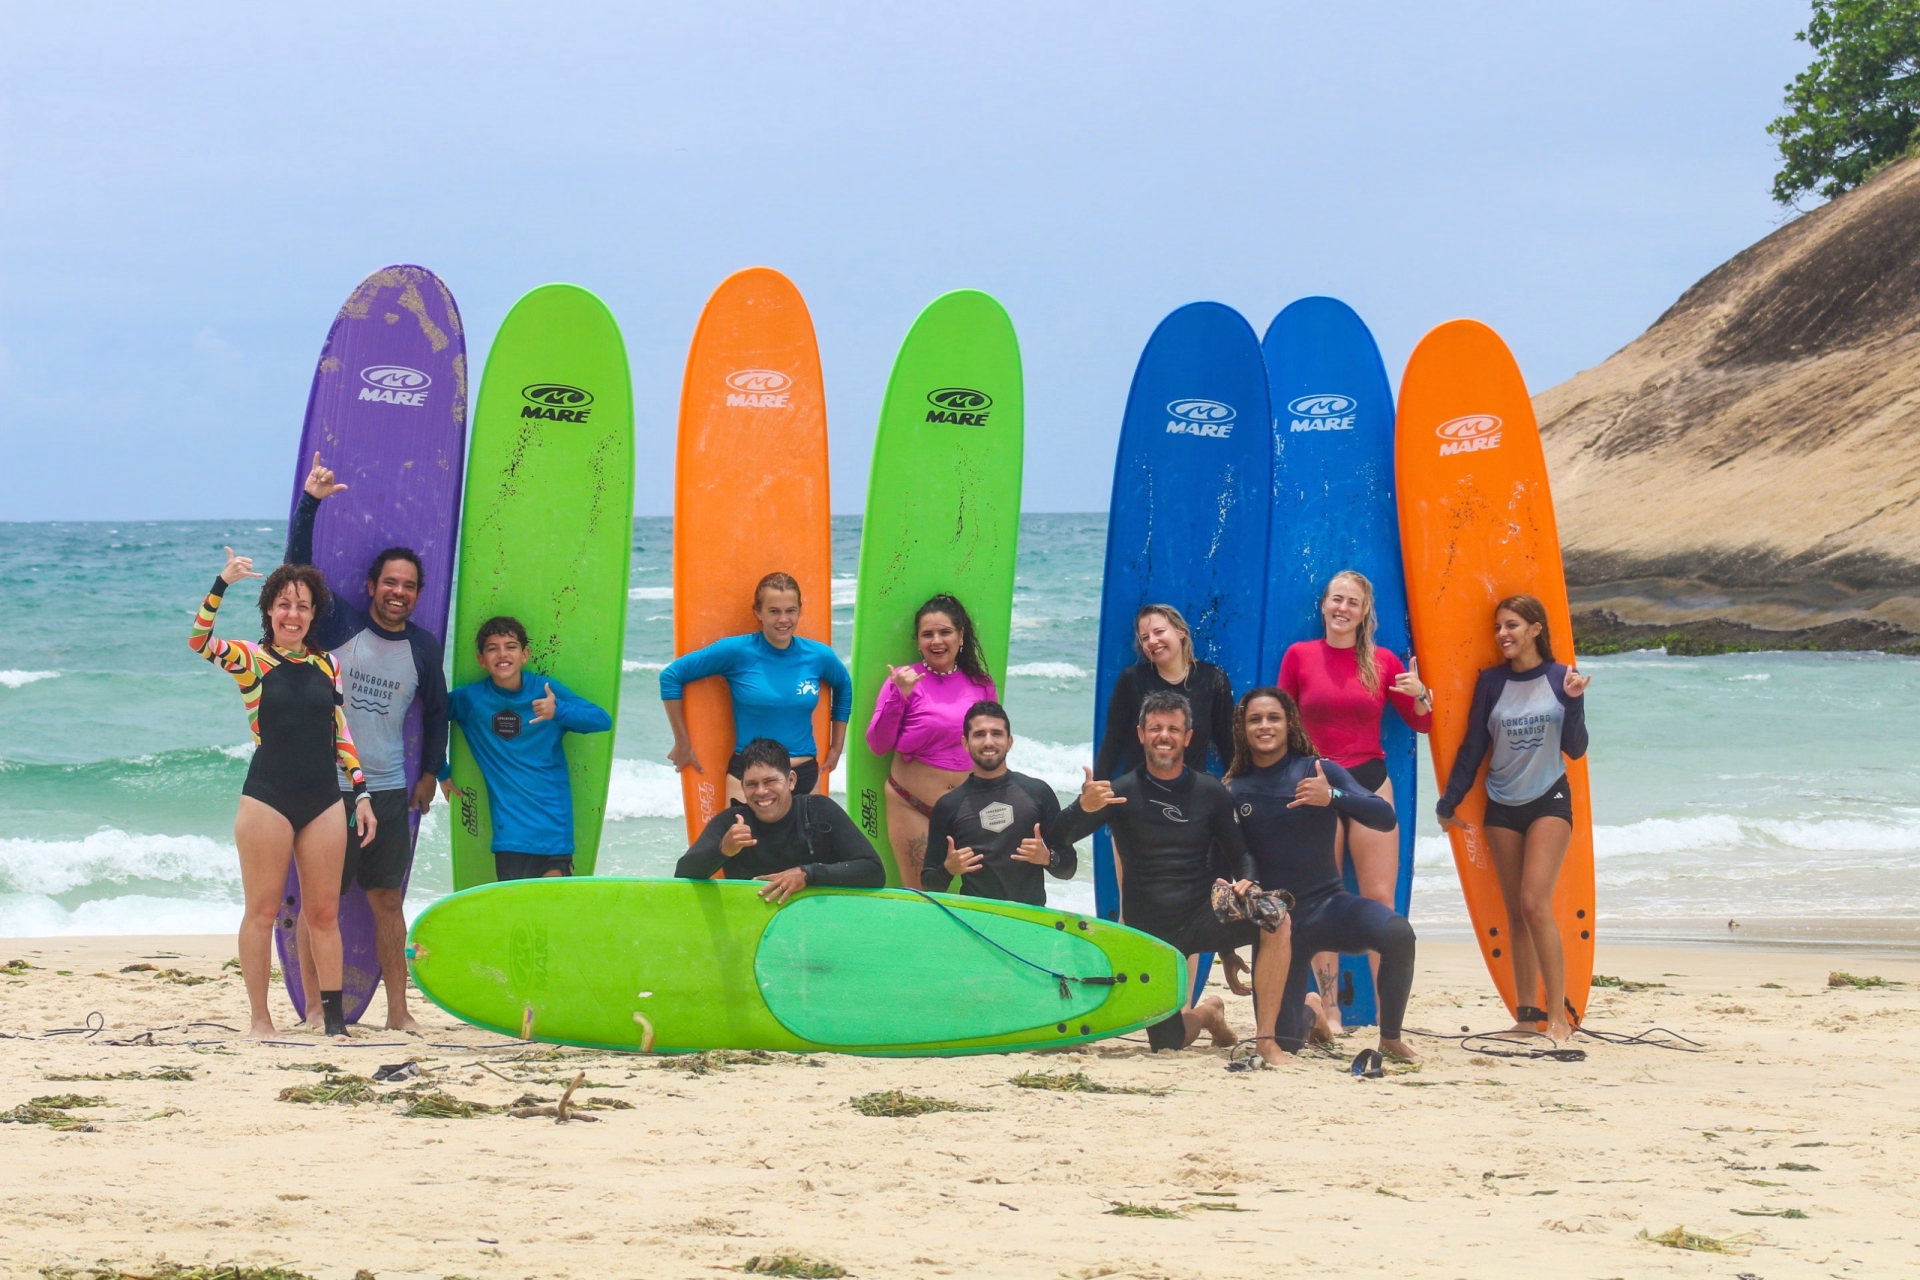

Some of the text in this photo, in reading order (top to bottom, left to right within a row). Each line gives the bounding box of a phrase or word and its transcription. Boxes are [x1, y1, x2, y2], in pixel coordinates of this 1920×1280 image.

[358, 388, 428, 407] MARÉ
[726, 392, 790, 408] MARÉ
[520, 405, 592, 424] MARÉ
[925, 410, 990, 427] MARÉ
[1290, 414, 1356, 432] MARÉ
[1165, 420, 1235, 438] MARÉ
[1439, 432, 1503, 457] MARÉ
[349, 667, 401, 690] LONGBOARD
[351, 682, 394, 700] PARADISE
[1501, 714, 1551, 727] LONGBOARD
[1507, 724, 1546, 737] PARADISE
